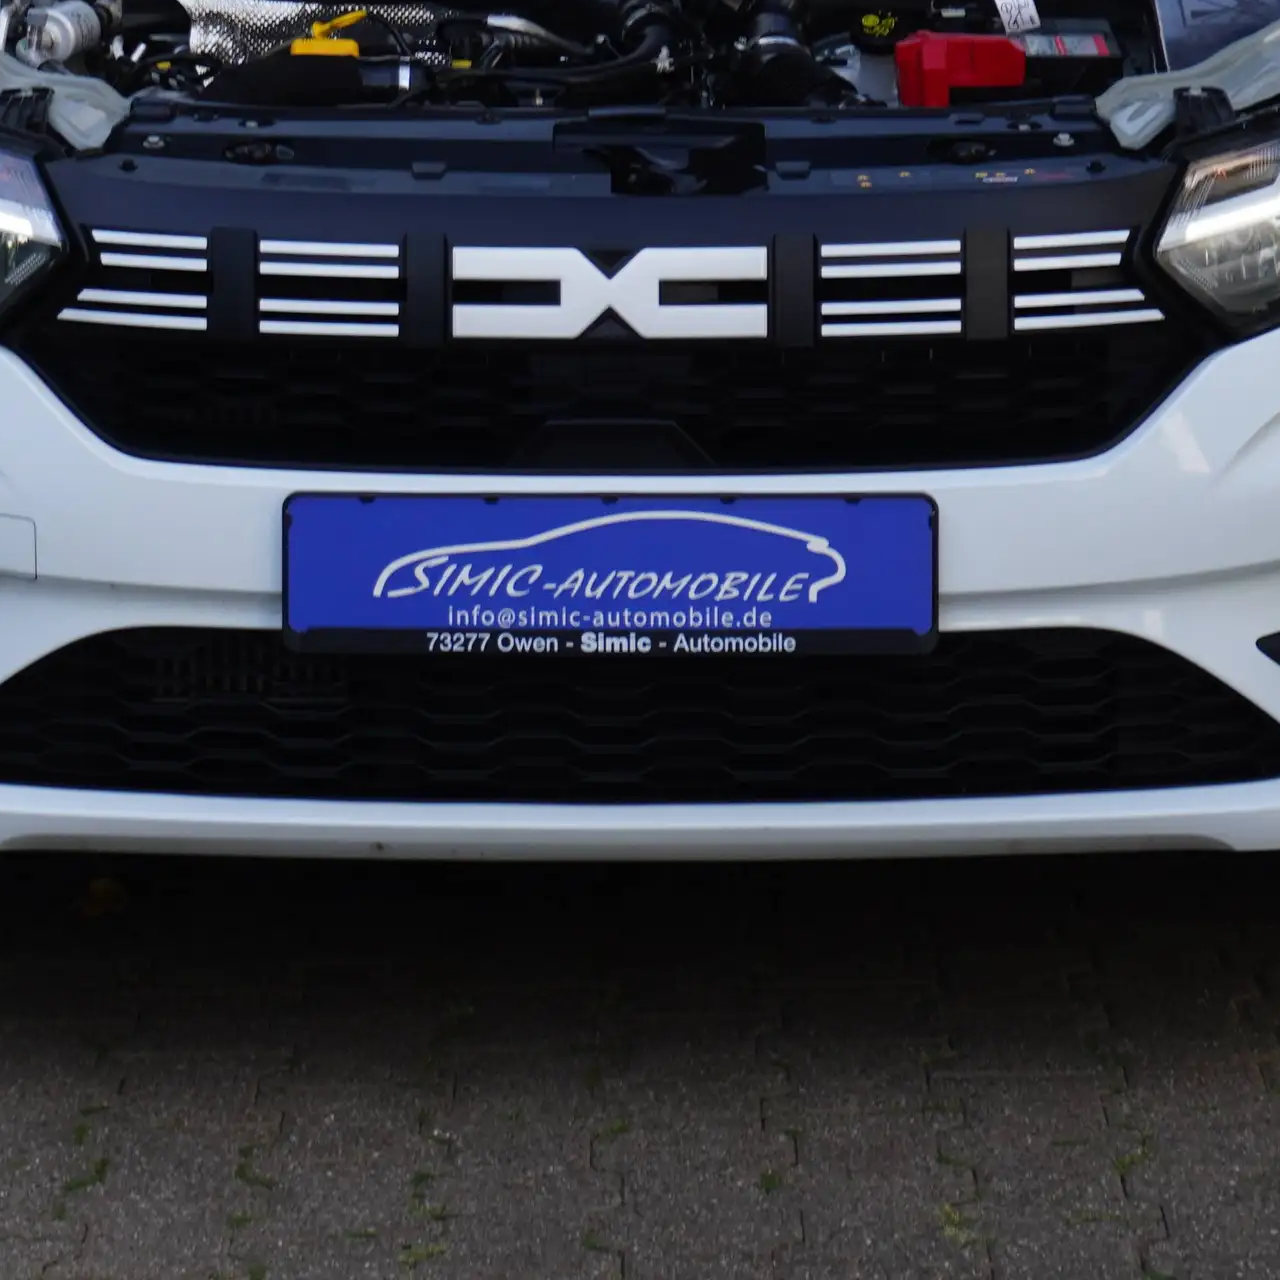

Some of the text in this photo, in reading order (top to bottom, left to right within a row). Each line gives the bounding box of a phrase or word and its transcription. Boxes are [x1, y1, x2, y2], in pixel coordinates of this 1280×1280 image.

[448, 604, 772, 629] info@simic-automobile.de
[426, 632, 491, 652] 73277
[497, 632, 559, 653] Owen
[580, 631, 652, 653] Simic
[673, 632, 797, 653] Automobile
